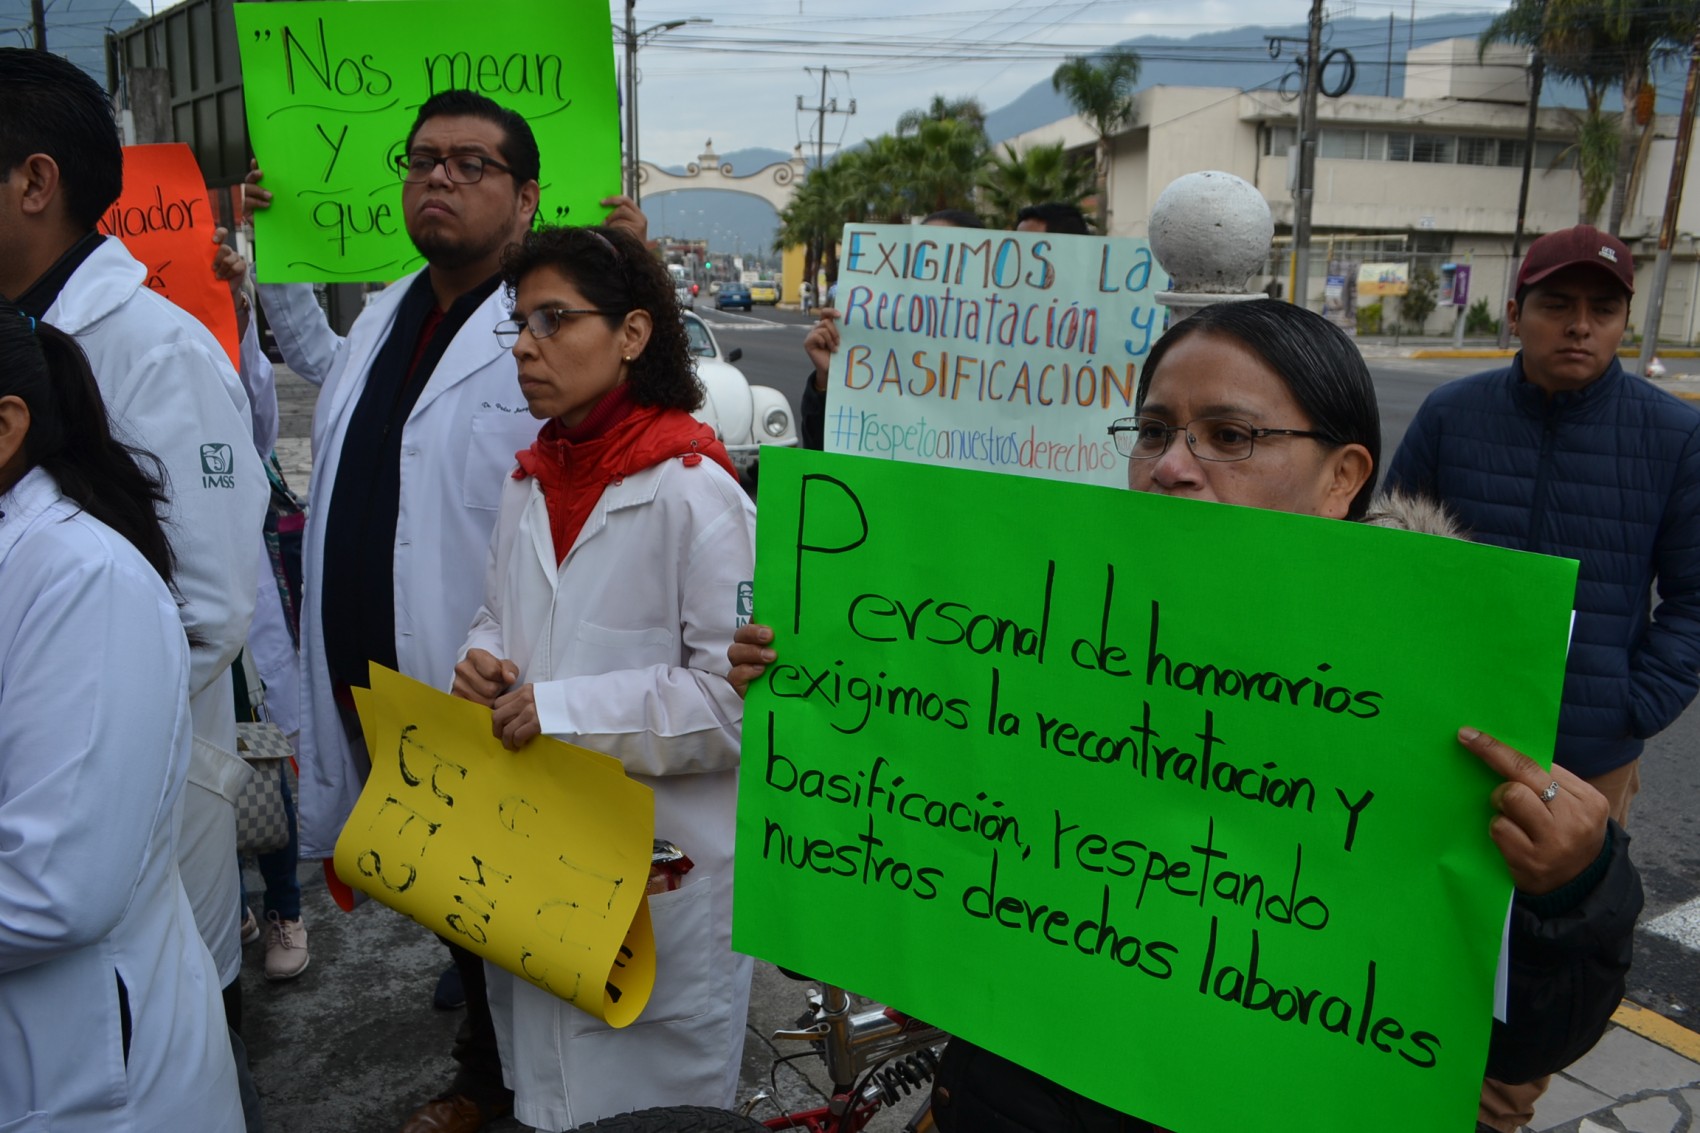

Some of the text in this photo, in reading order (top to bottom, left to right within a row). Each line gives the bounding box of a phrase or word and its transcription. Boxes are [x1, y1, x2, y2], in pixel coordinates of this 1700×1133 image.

[424, 51, 565, 101] mean
[313, 200, 398, 257] que
[846, 231, 1055, 290] EXIGIMOS
[844, 285, 1156, 356] Recontratación y
[844, 344, 1137, 409] BASIFICACIÓN
[828, 404, 1118, 473] #respetoanuestrosderechos
[202, 475, 235, 489] IMSS
[794, 474, 1383, 718] Personal de honorarios
[768, 659, 970, 735] exigimos
[989, 668, 1020, 736] la
[1055, 810, 1330, 931] respetando
[763, 814, 1442, 1068] nuestros derechos laborales
